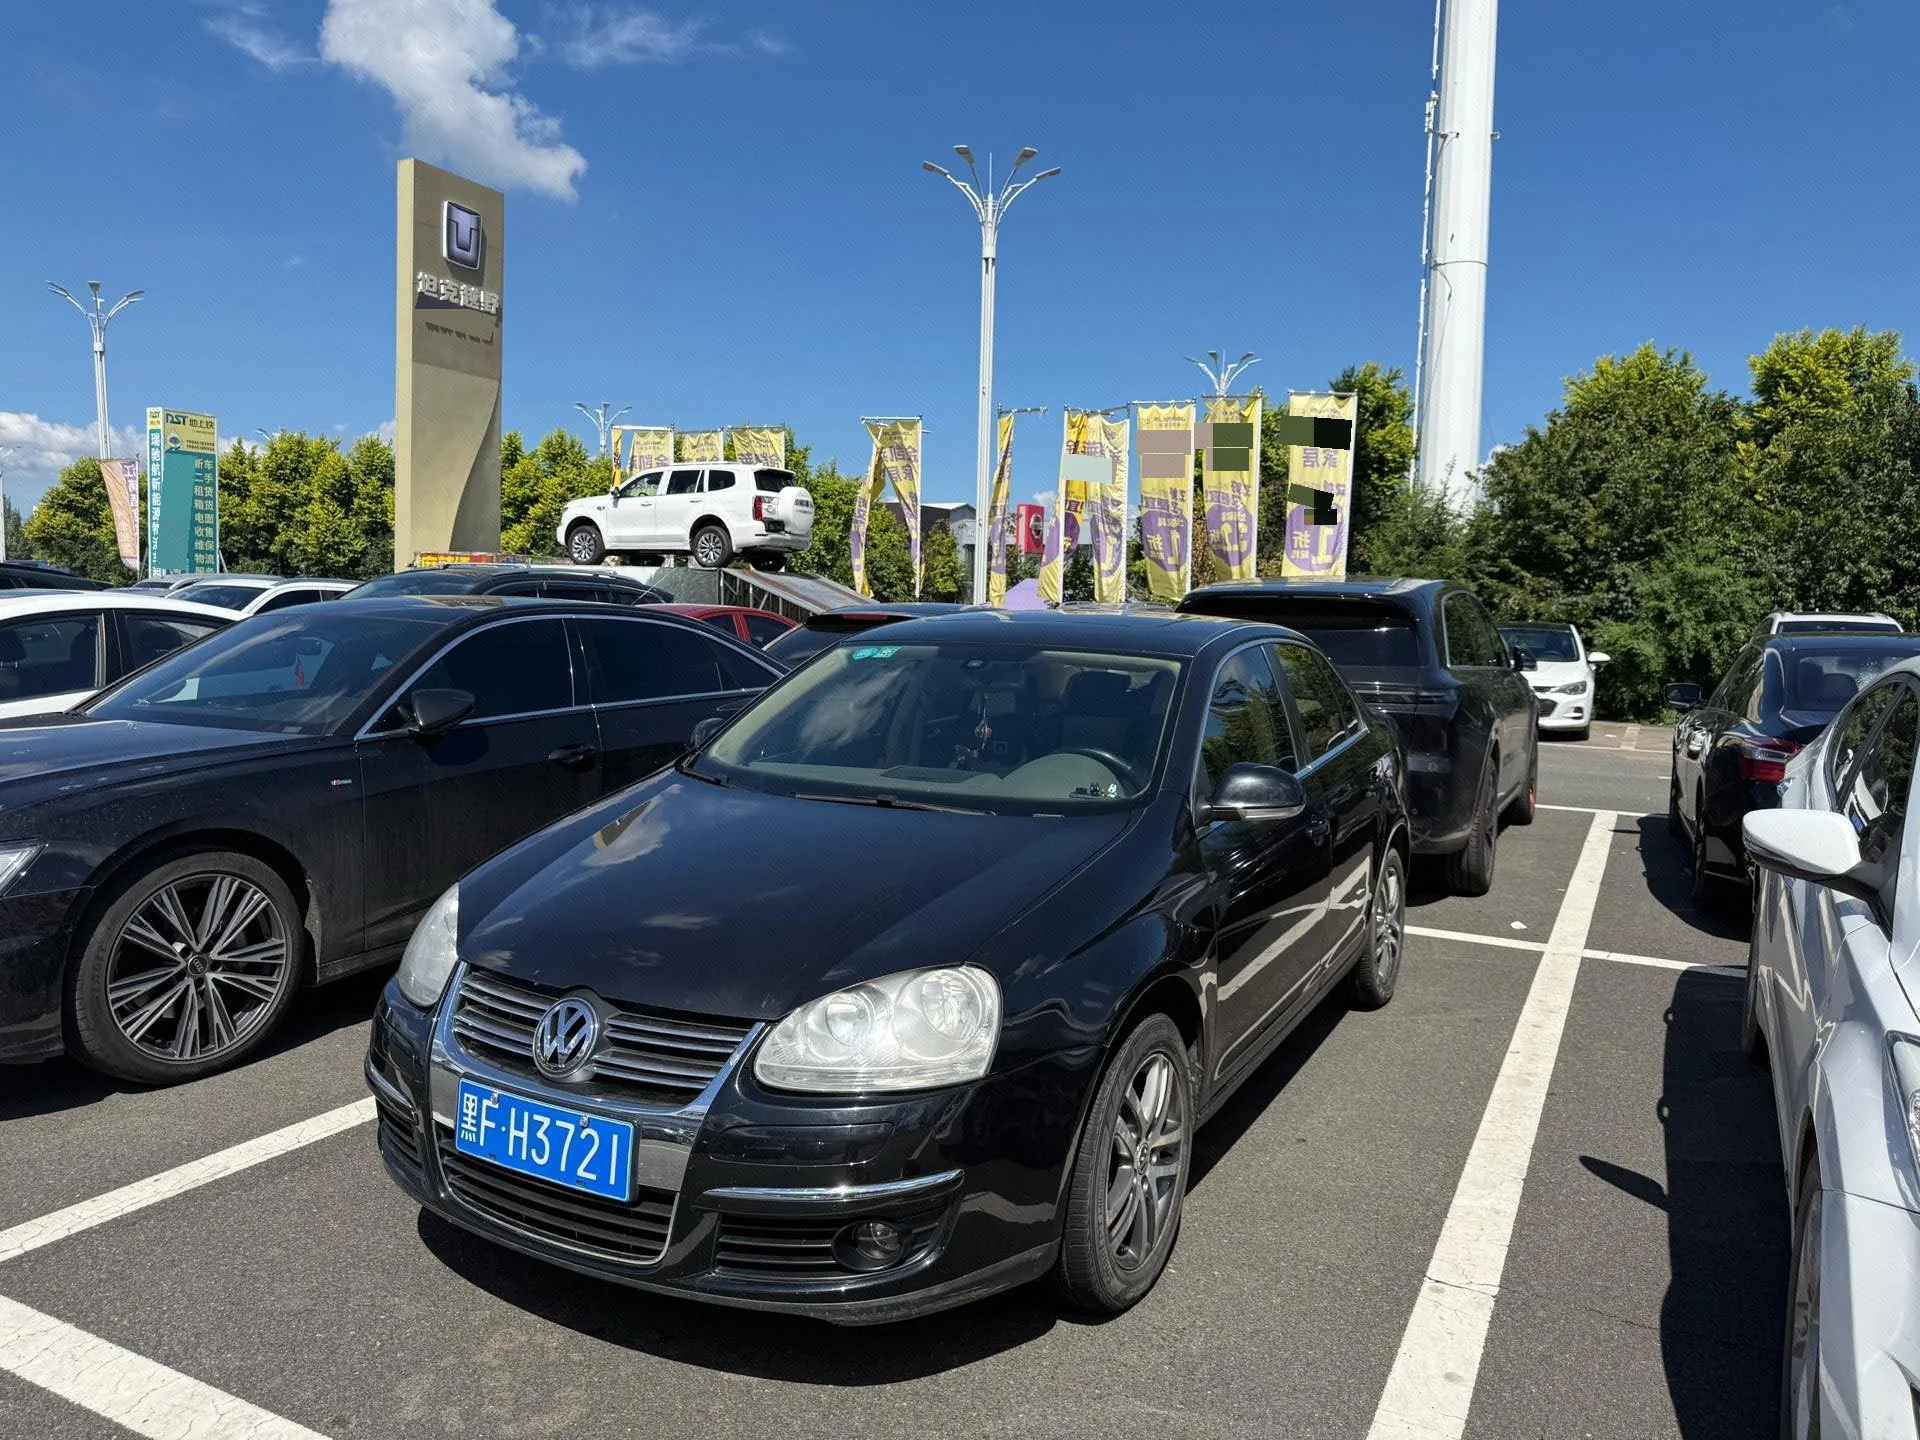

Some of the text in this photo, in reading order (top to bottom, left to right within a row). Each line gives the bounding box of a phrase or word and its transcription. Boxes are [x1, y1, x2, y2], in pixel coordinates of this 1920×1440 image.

[417, 272, 499, 314] 坦克越野
[195, 459, 213, 470] 新车
[195, 473, 213, 484] 二手
